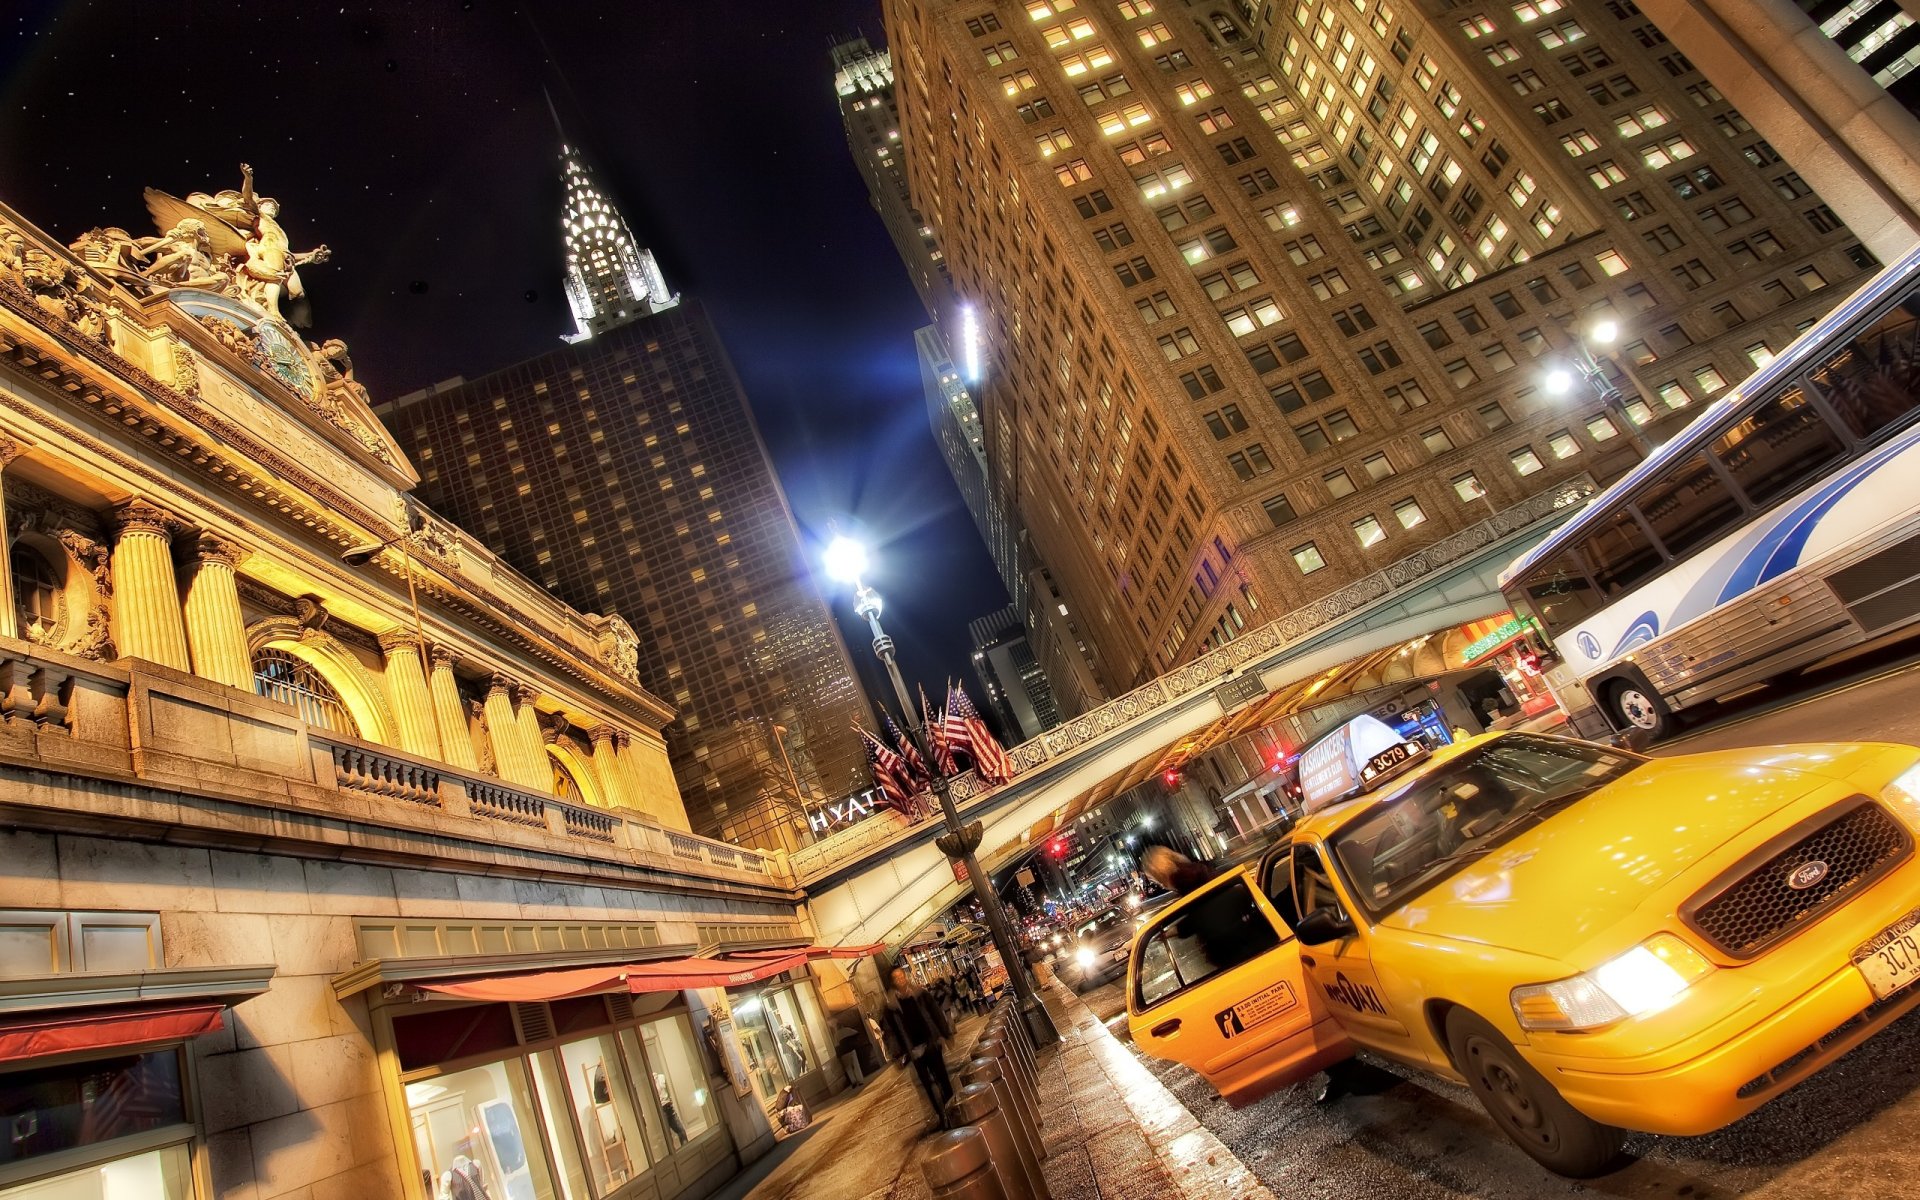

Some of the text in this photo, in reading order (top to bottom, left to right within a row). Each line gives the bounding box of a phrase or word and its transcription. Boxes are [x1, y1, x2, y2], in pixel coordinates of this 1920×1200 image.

[1225, 679, 1254, 695] PERSHING
[1231, 686, 1253, 700] SQUARE
[1299, 730, 1345, 778] FLASHDANCERS
[1373, 746, 1405, 771] 3C79
[810, 785, 889, 832] HYATT
[1799, 866, 1821, 884] Ford
[1869, 919, 1917, 952] NEW YORK
[1879, 935, 1920, 976] 3C79
